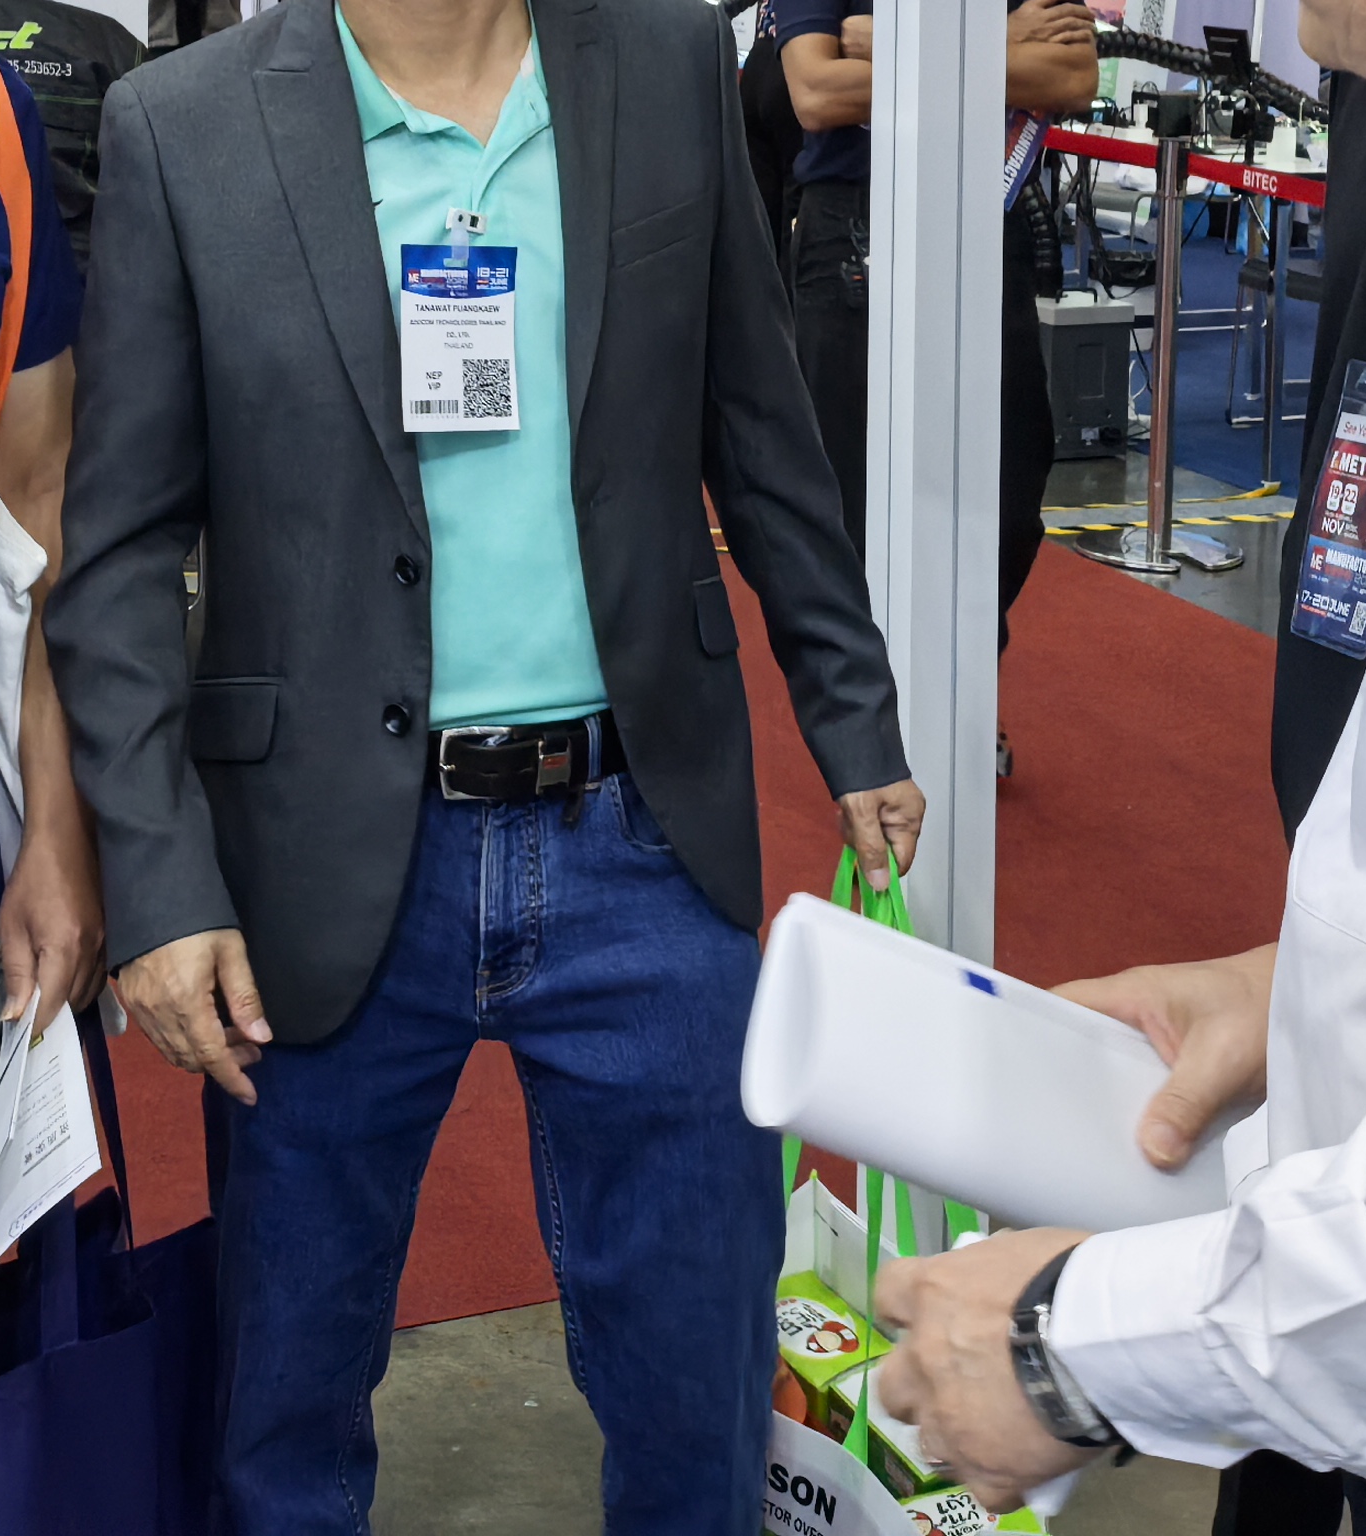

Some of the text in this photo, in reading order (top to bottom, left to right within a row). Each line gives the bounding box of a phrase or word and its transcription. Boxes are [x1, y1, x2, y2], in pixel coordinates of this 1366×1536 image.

[1242, 168, 1279, 194] BITEC
[414, 303, 451, 312] TANAWAT
[1342, 421, 1357, 436] See
[1321, 517, 1345, 536] NOV
[1329, 598, 1351, 617] JUNE
